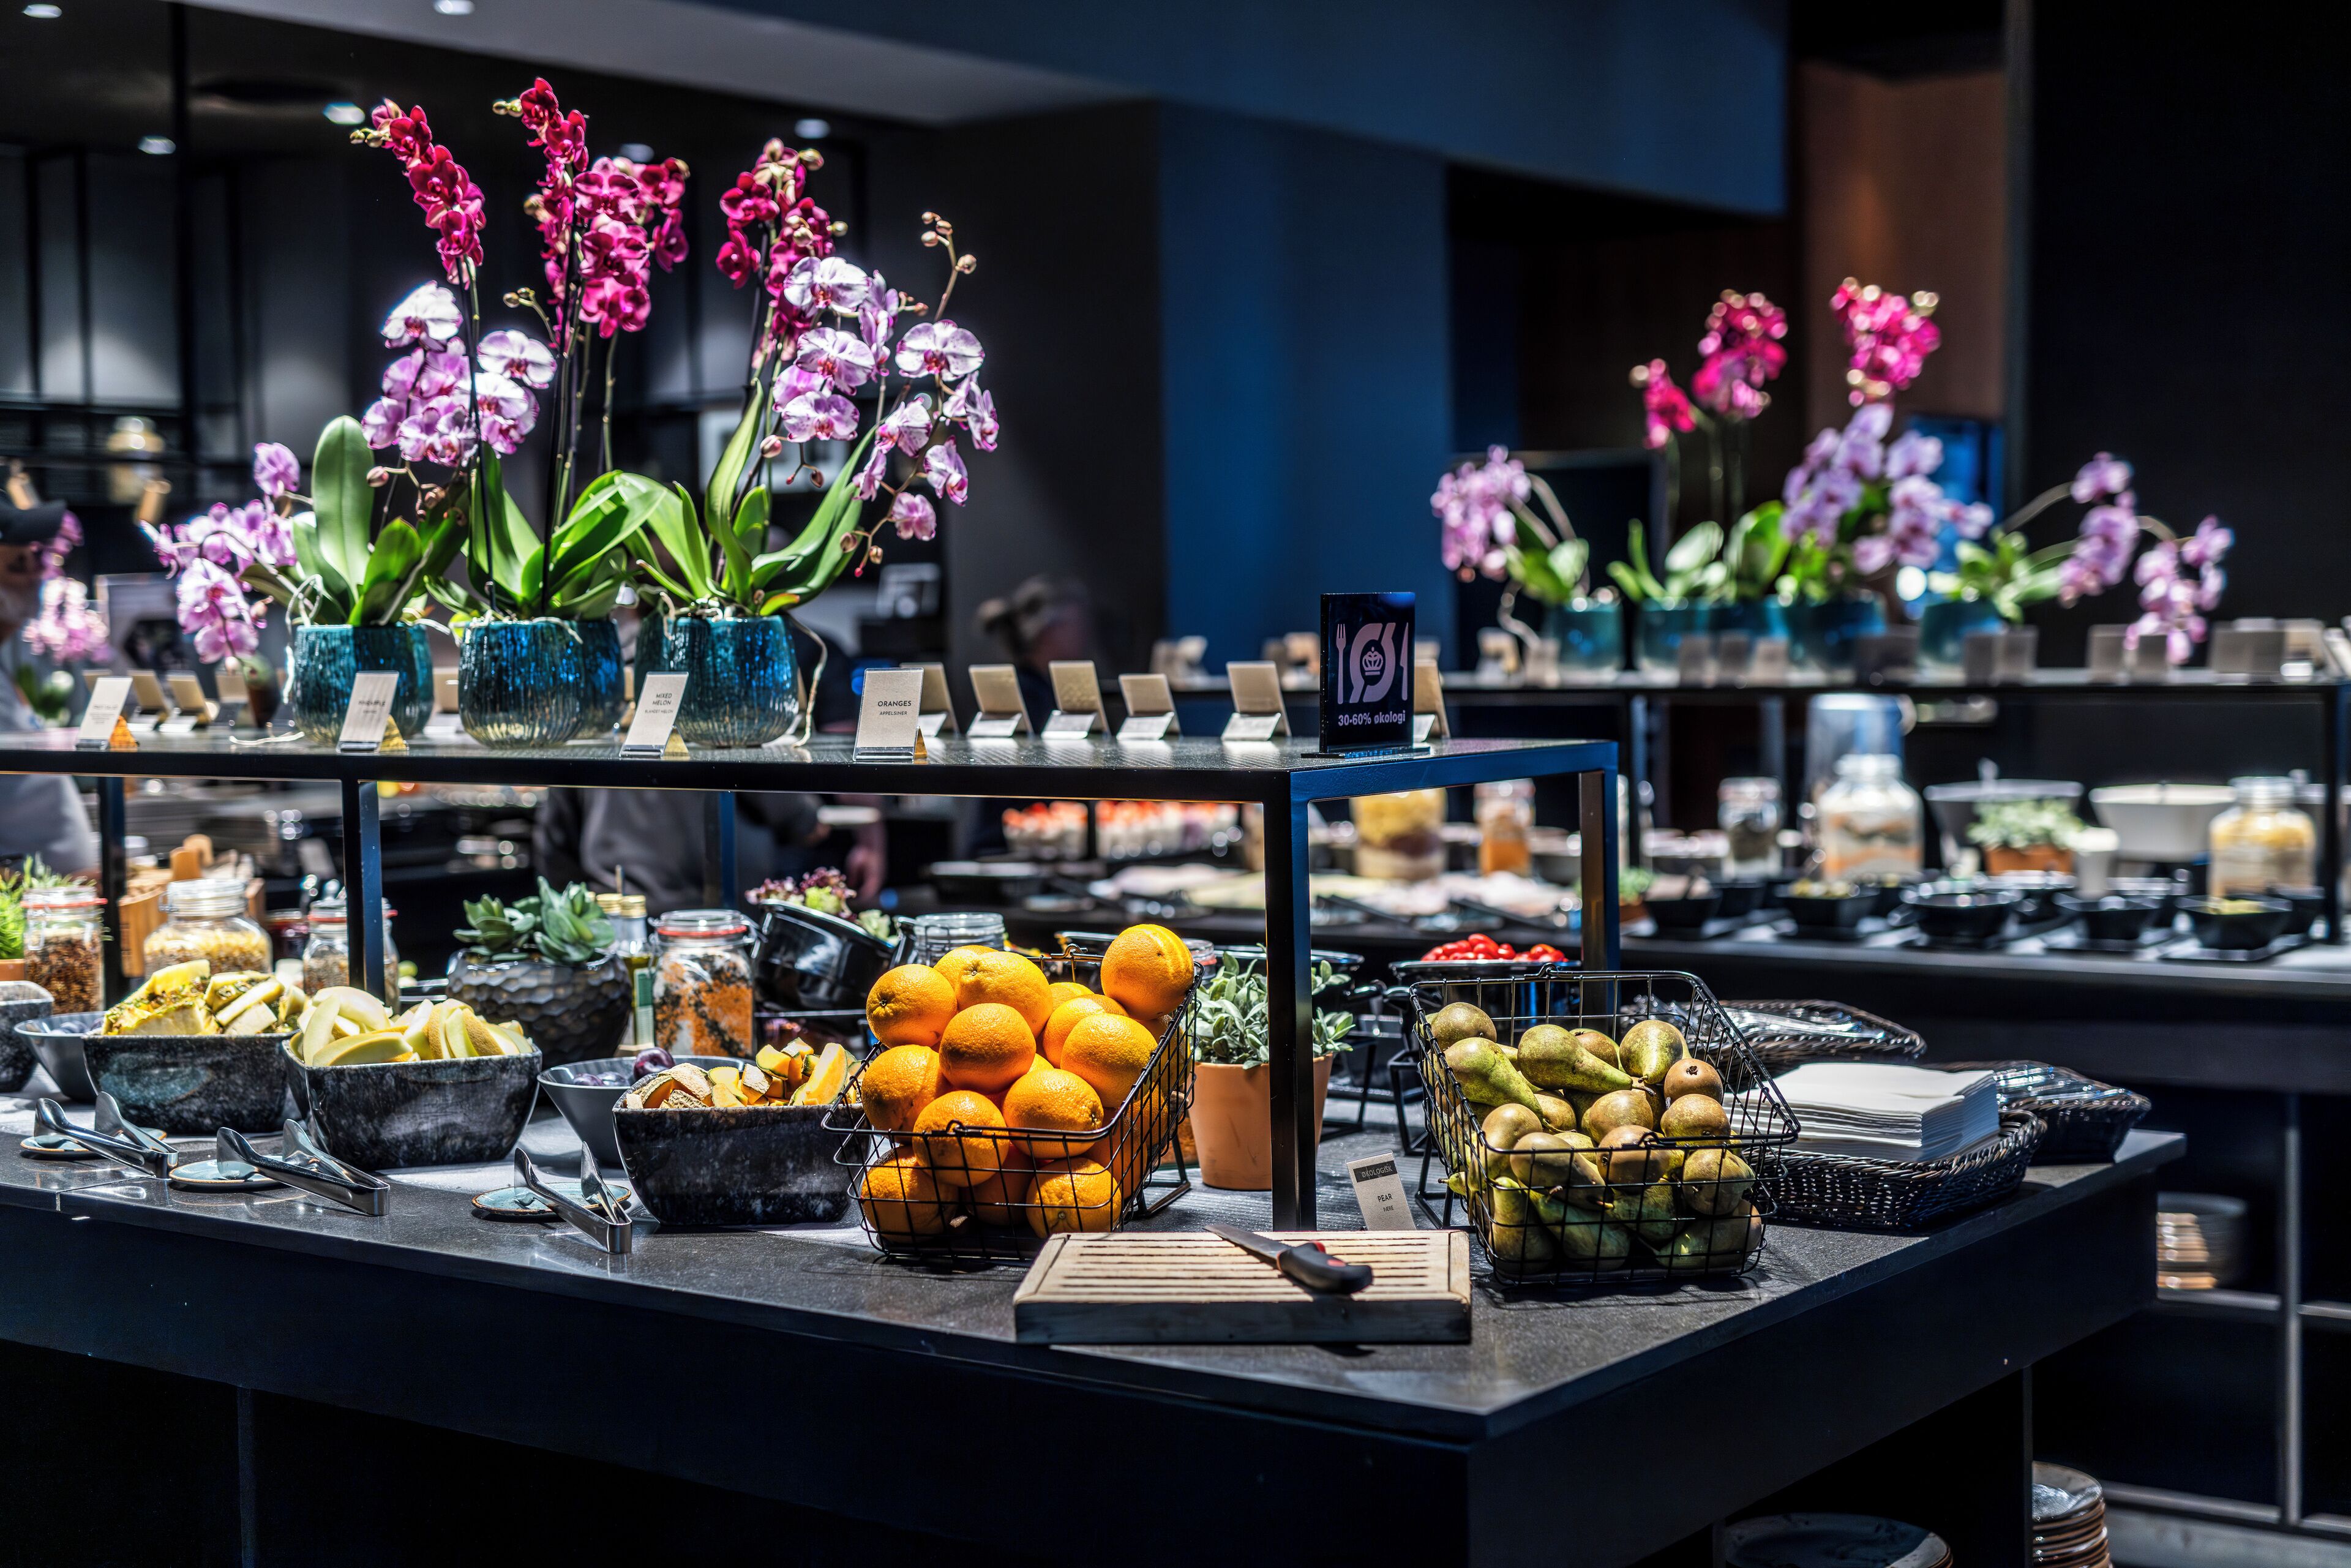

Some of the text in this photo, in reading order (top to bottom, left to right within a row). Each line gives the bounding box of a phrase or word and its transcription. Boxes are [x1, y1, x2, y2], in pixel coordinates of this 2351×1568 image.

[1338, 710, 1406, 727] 30-60% økologi
[1362, 1165, 1393, 1178] ØKOLOGISK
[1377, 1193, 1393, 1202] PEAR
